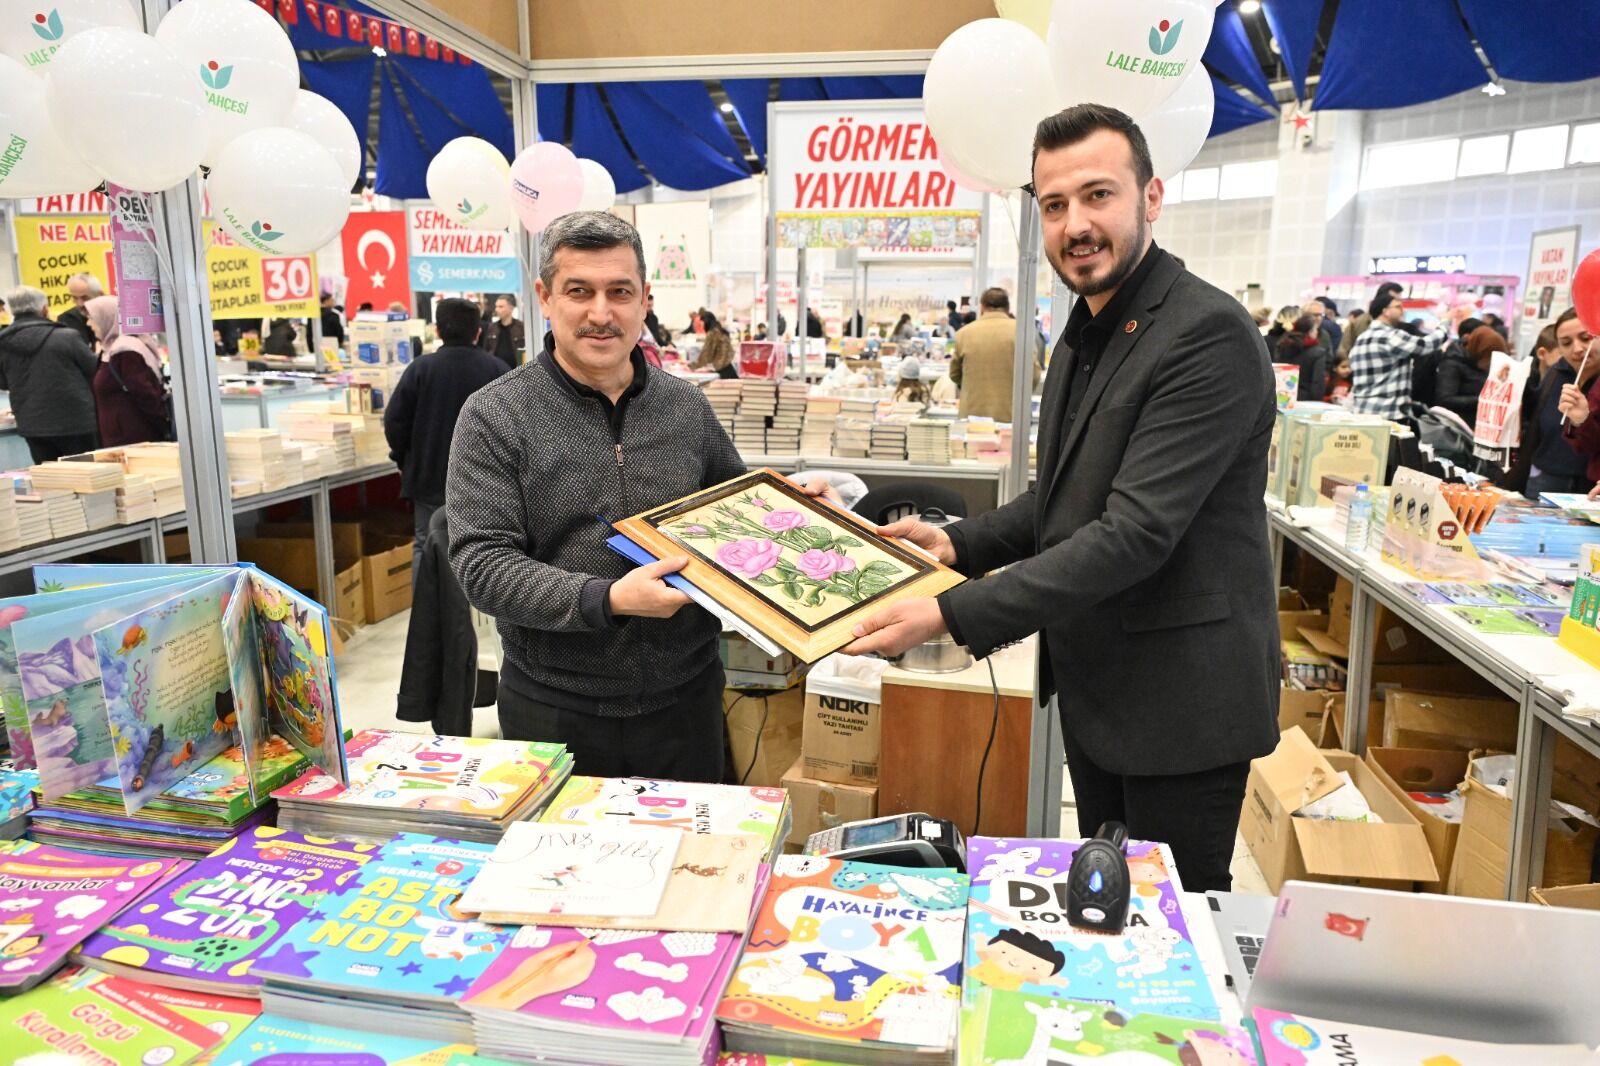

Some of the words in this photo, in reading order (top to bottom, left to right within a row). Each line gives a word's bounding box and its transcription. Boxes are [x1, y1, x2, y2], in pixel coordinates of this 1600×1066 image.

[23, 47, 51, 66] LALE
[1106, 50, 1141, 72] LALE
[1140, 58, 1188, 80] BAHÇESİ
[807, 117, 938, 162] GÖRMEK
[36, 190, 108, 212] YAYIN
[795, 171, 956, 209] YAYINLARI
[40, 225, 67, 241] NE
[74, 224, 112, 241] ALI
[422, 235, 501, 254] YAYINLARI
[38, 253, 88, 271] ÇOCUK
[211, 260, 248, 274] ÇOCUK
[438, 269, 505, 280] SEMERKAND
[212, 276, 250, 292] HİKAYE
[264, 259, 310, 300] 30
[211, 294, 260, 312] İTAPLARI
[629, 796, 693, 831] BOY
[225, 858, 284, 874] NEREDE
[359, 876, 461, 908] AST
[340, 899, 418, 928] RO
[802, 894, 929, 922] HAYALİNCE
[307, 922, 423, 957] NOT
[788, 914, 938, 962] BOYA
[70, 1003, 140, 1042] Görgü
